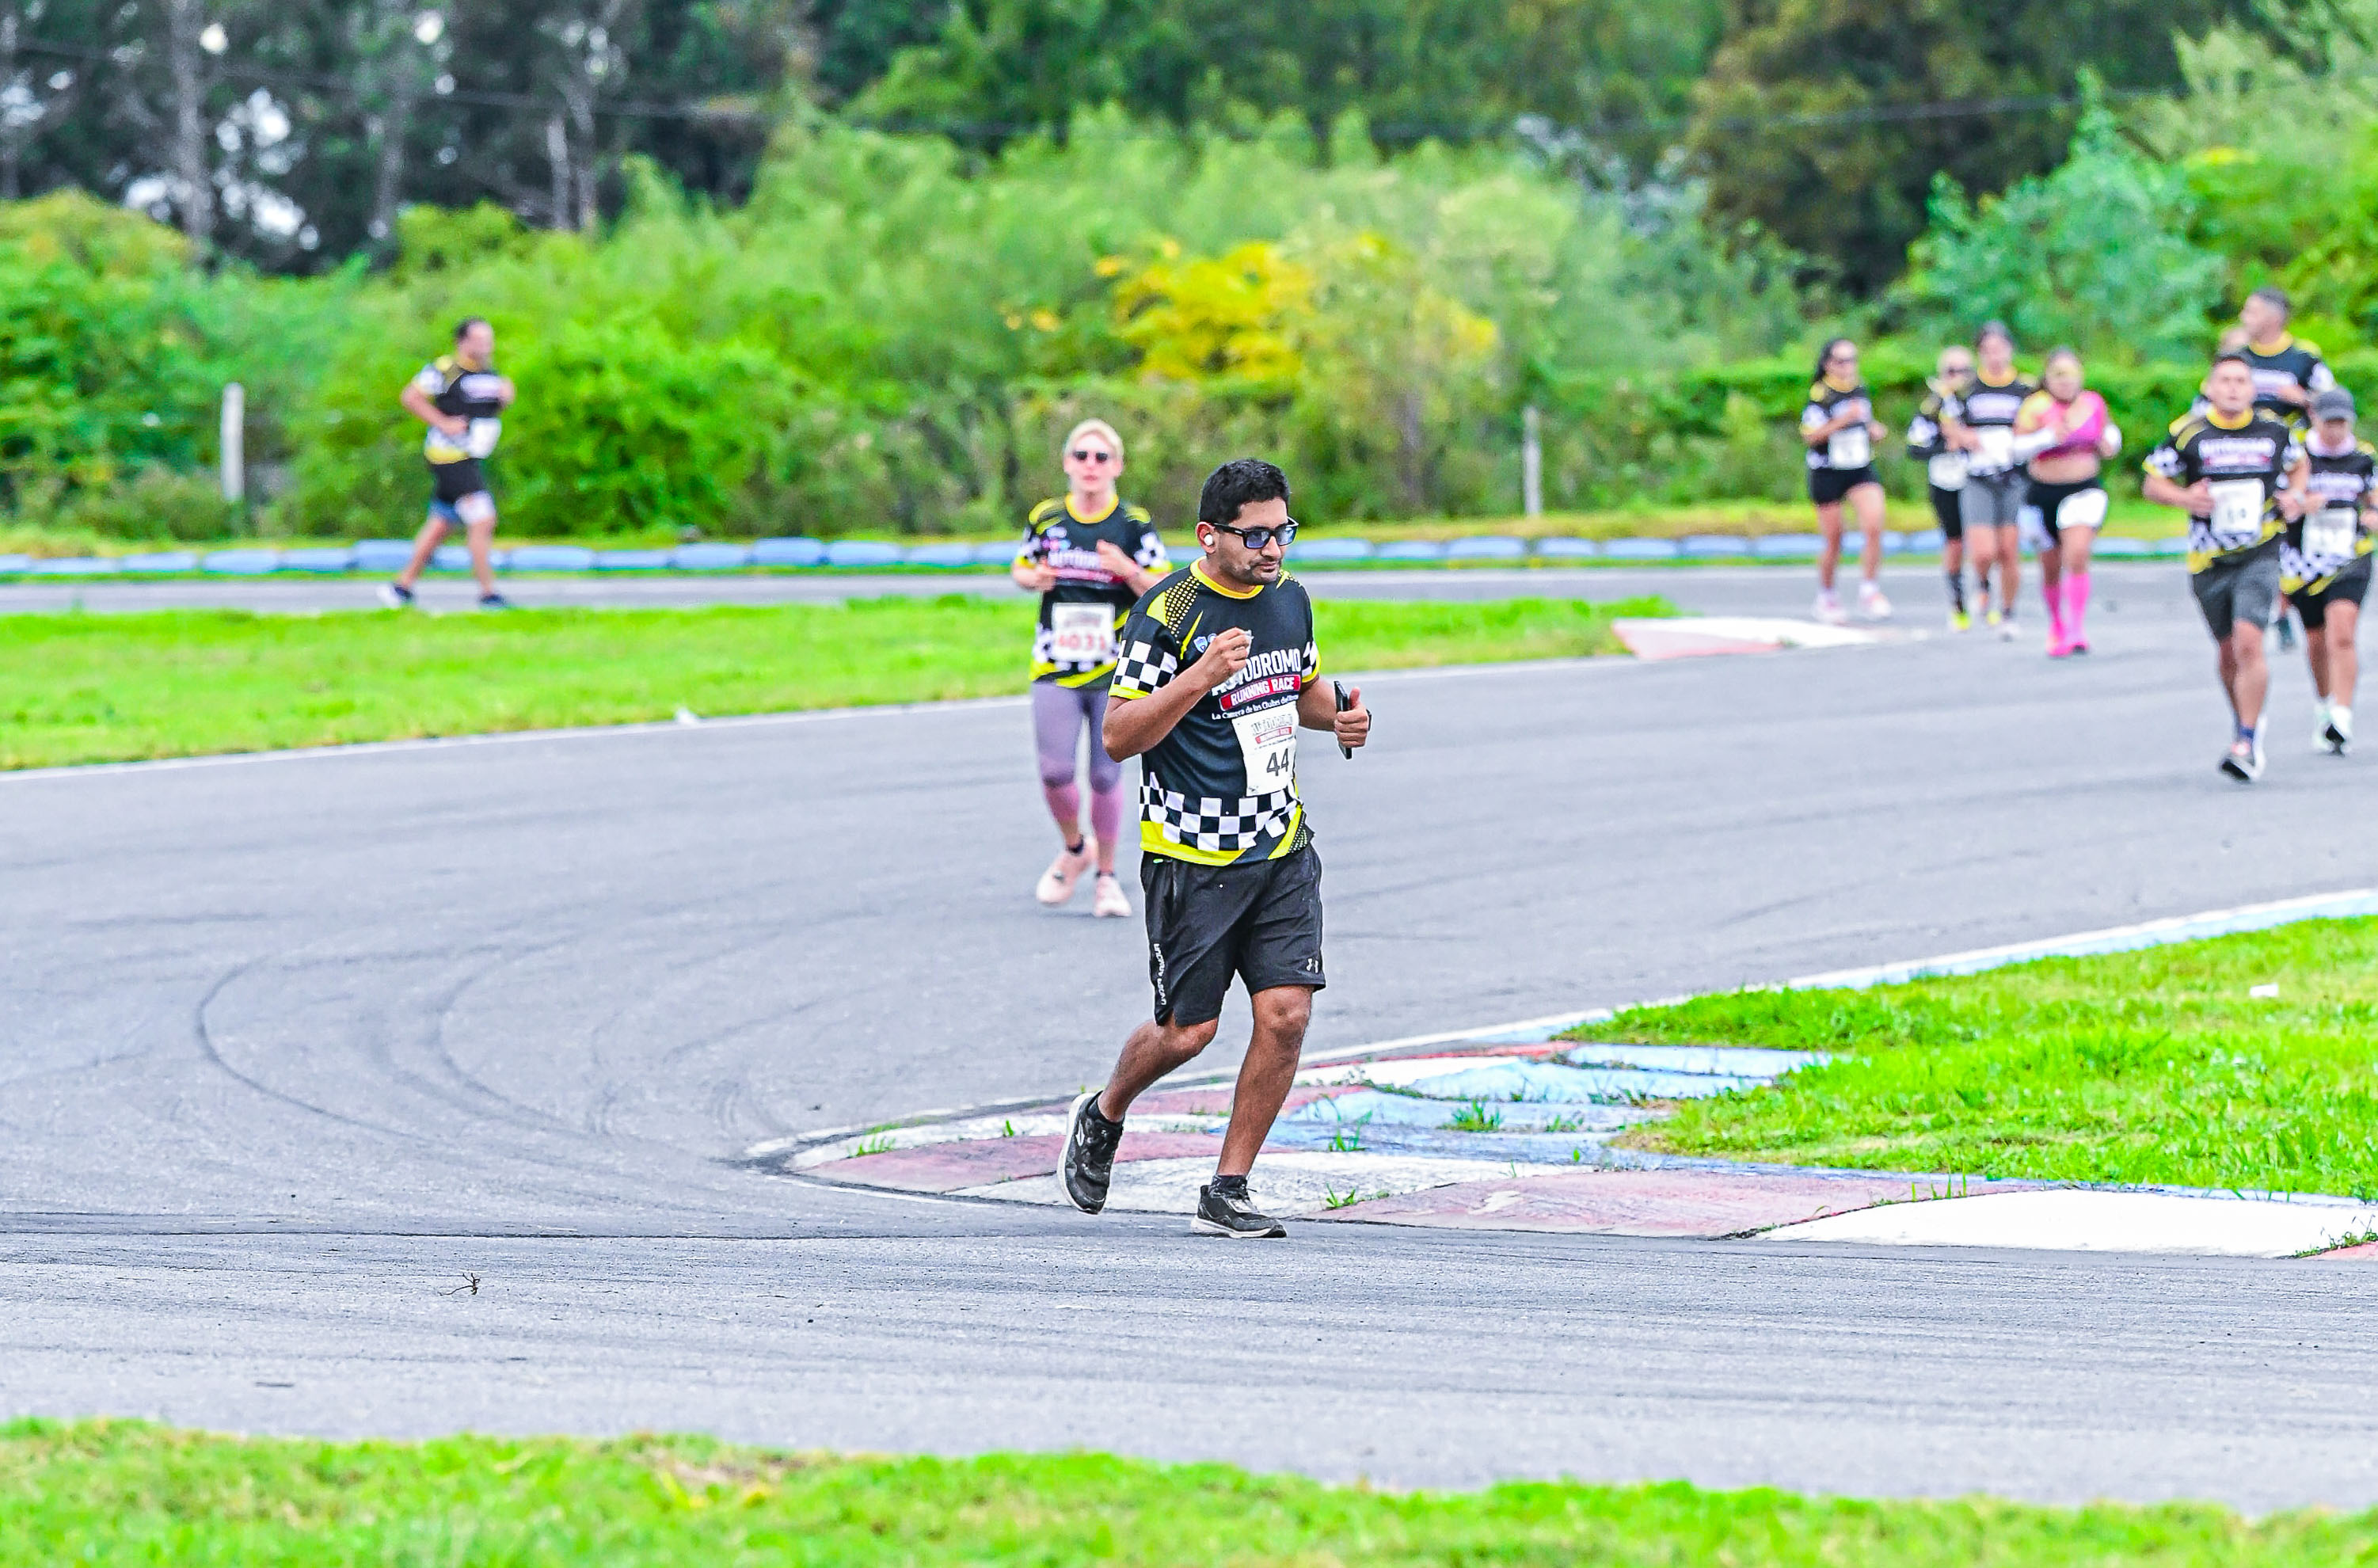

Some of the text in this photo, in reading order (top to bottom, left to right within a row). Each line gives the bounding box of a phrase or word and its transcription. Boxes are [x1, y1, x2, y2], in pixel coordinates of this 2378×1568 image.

[1230, 676, 1295, 706] RUNNING RACE
[1266, 748, 1289, 776] 44
